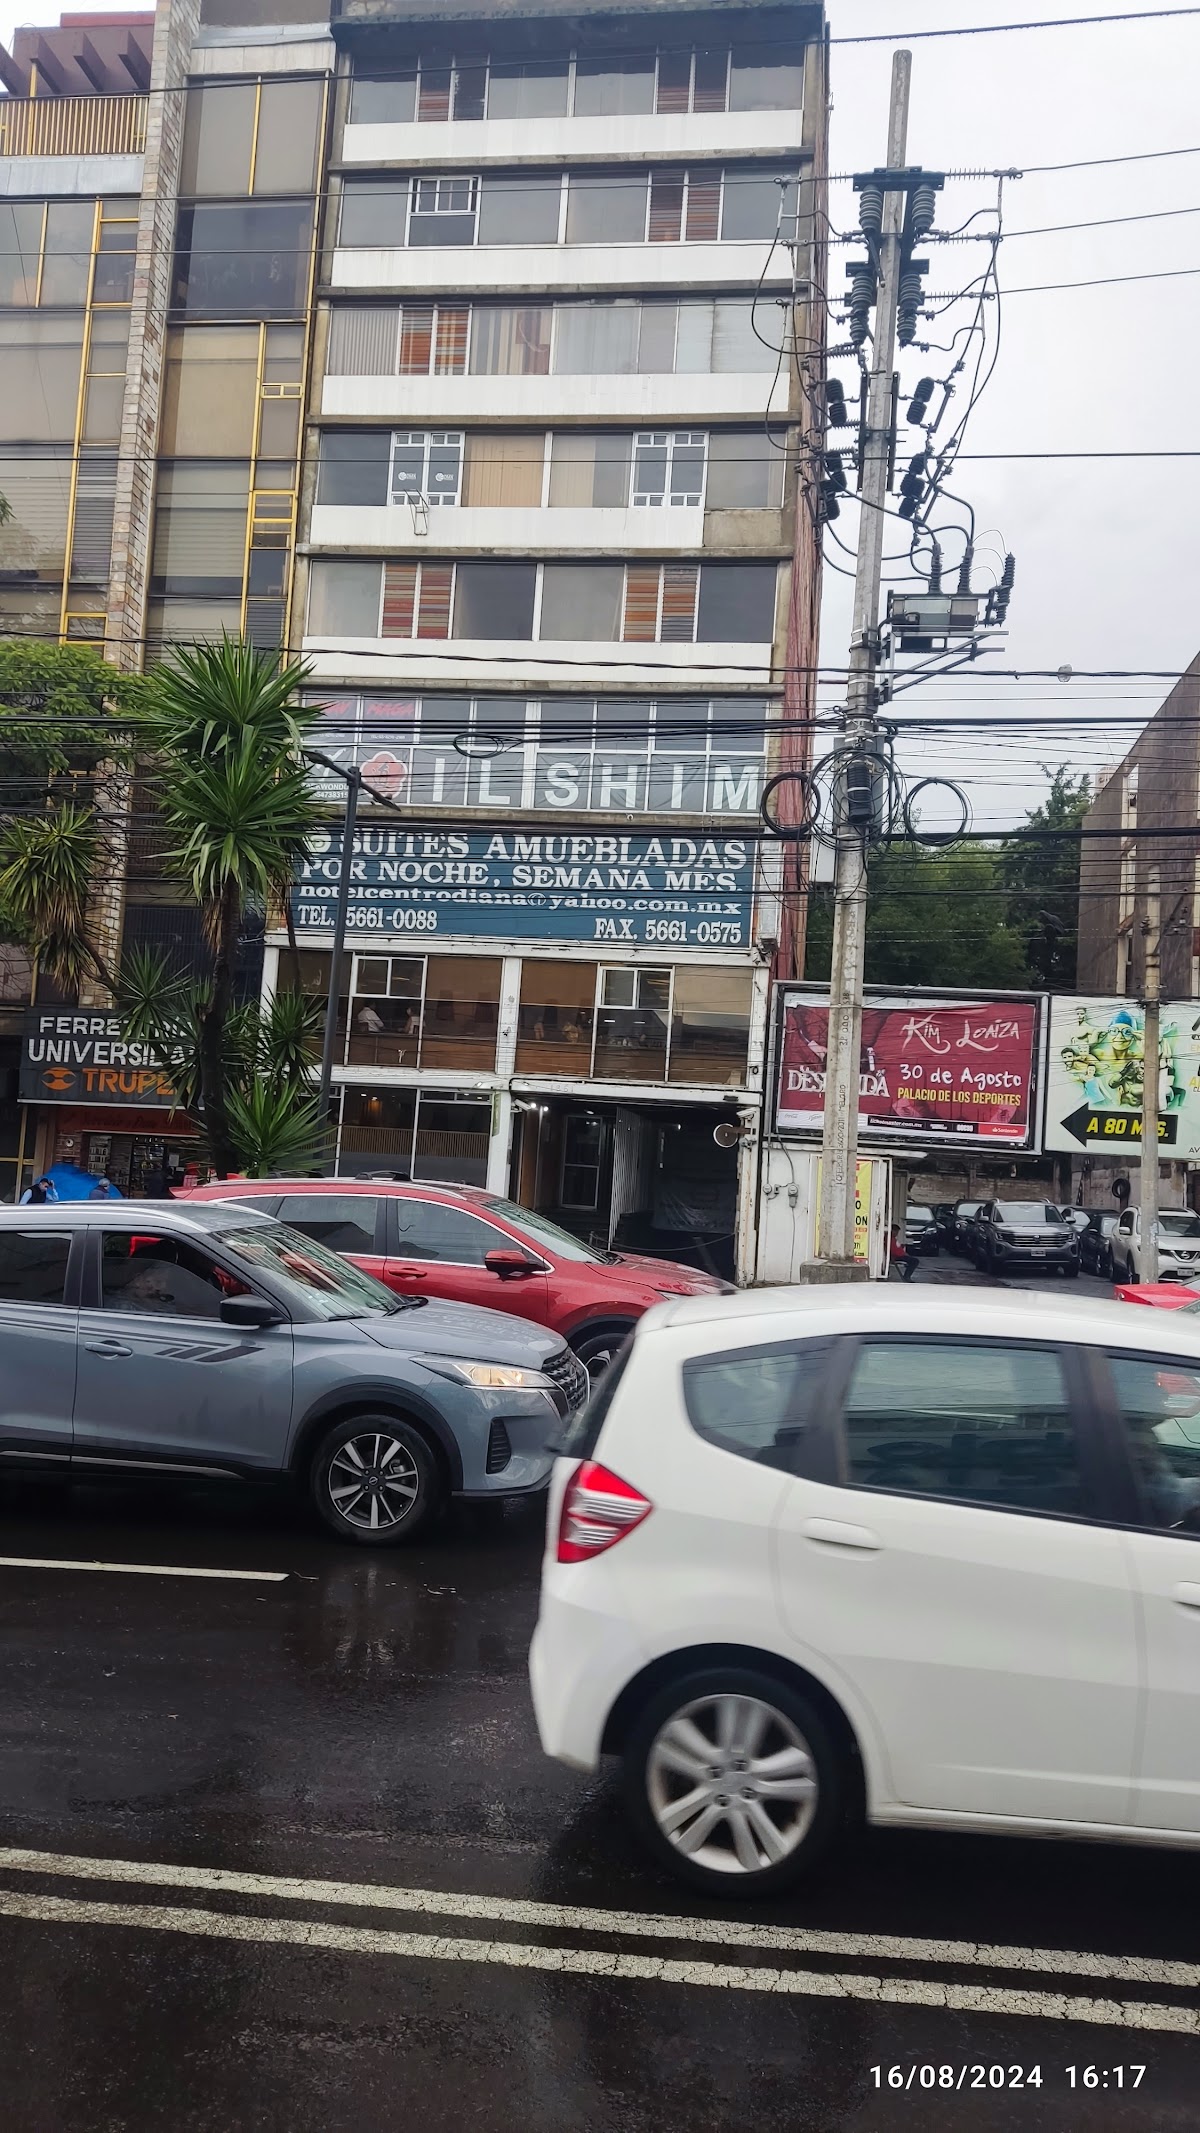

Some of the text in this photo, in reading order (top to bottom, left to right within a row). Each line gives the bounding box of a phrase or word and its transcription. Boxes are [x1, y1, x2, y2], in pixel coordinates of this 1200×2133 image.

[339, 828, 747, 870] SUITES AMUEBLADAS
[300, 857, 368, 881] POR
[512, 865, 654, 891] SEMANA
[664, 870, 743, 892] MES.
[297, 904, 742, 944] TEL. 5661-0088 FAX. 5661-0575
[39, 1016, 192, 1038] FERRERÍ
[82, 1068, 191, 1096] TRUPE
[787, 1067, 890, 1098] DESDA
[900, 1063, 1022, 1091] 30 de Agosto
[898, 1087, 1022, 1106] PALACIO DE LOS DEPORTES
[1086, 1117, 1169, 1137] A 80 MS.
